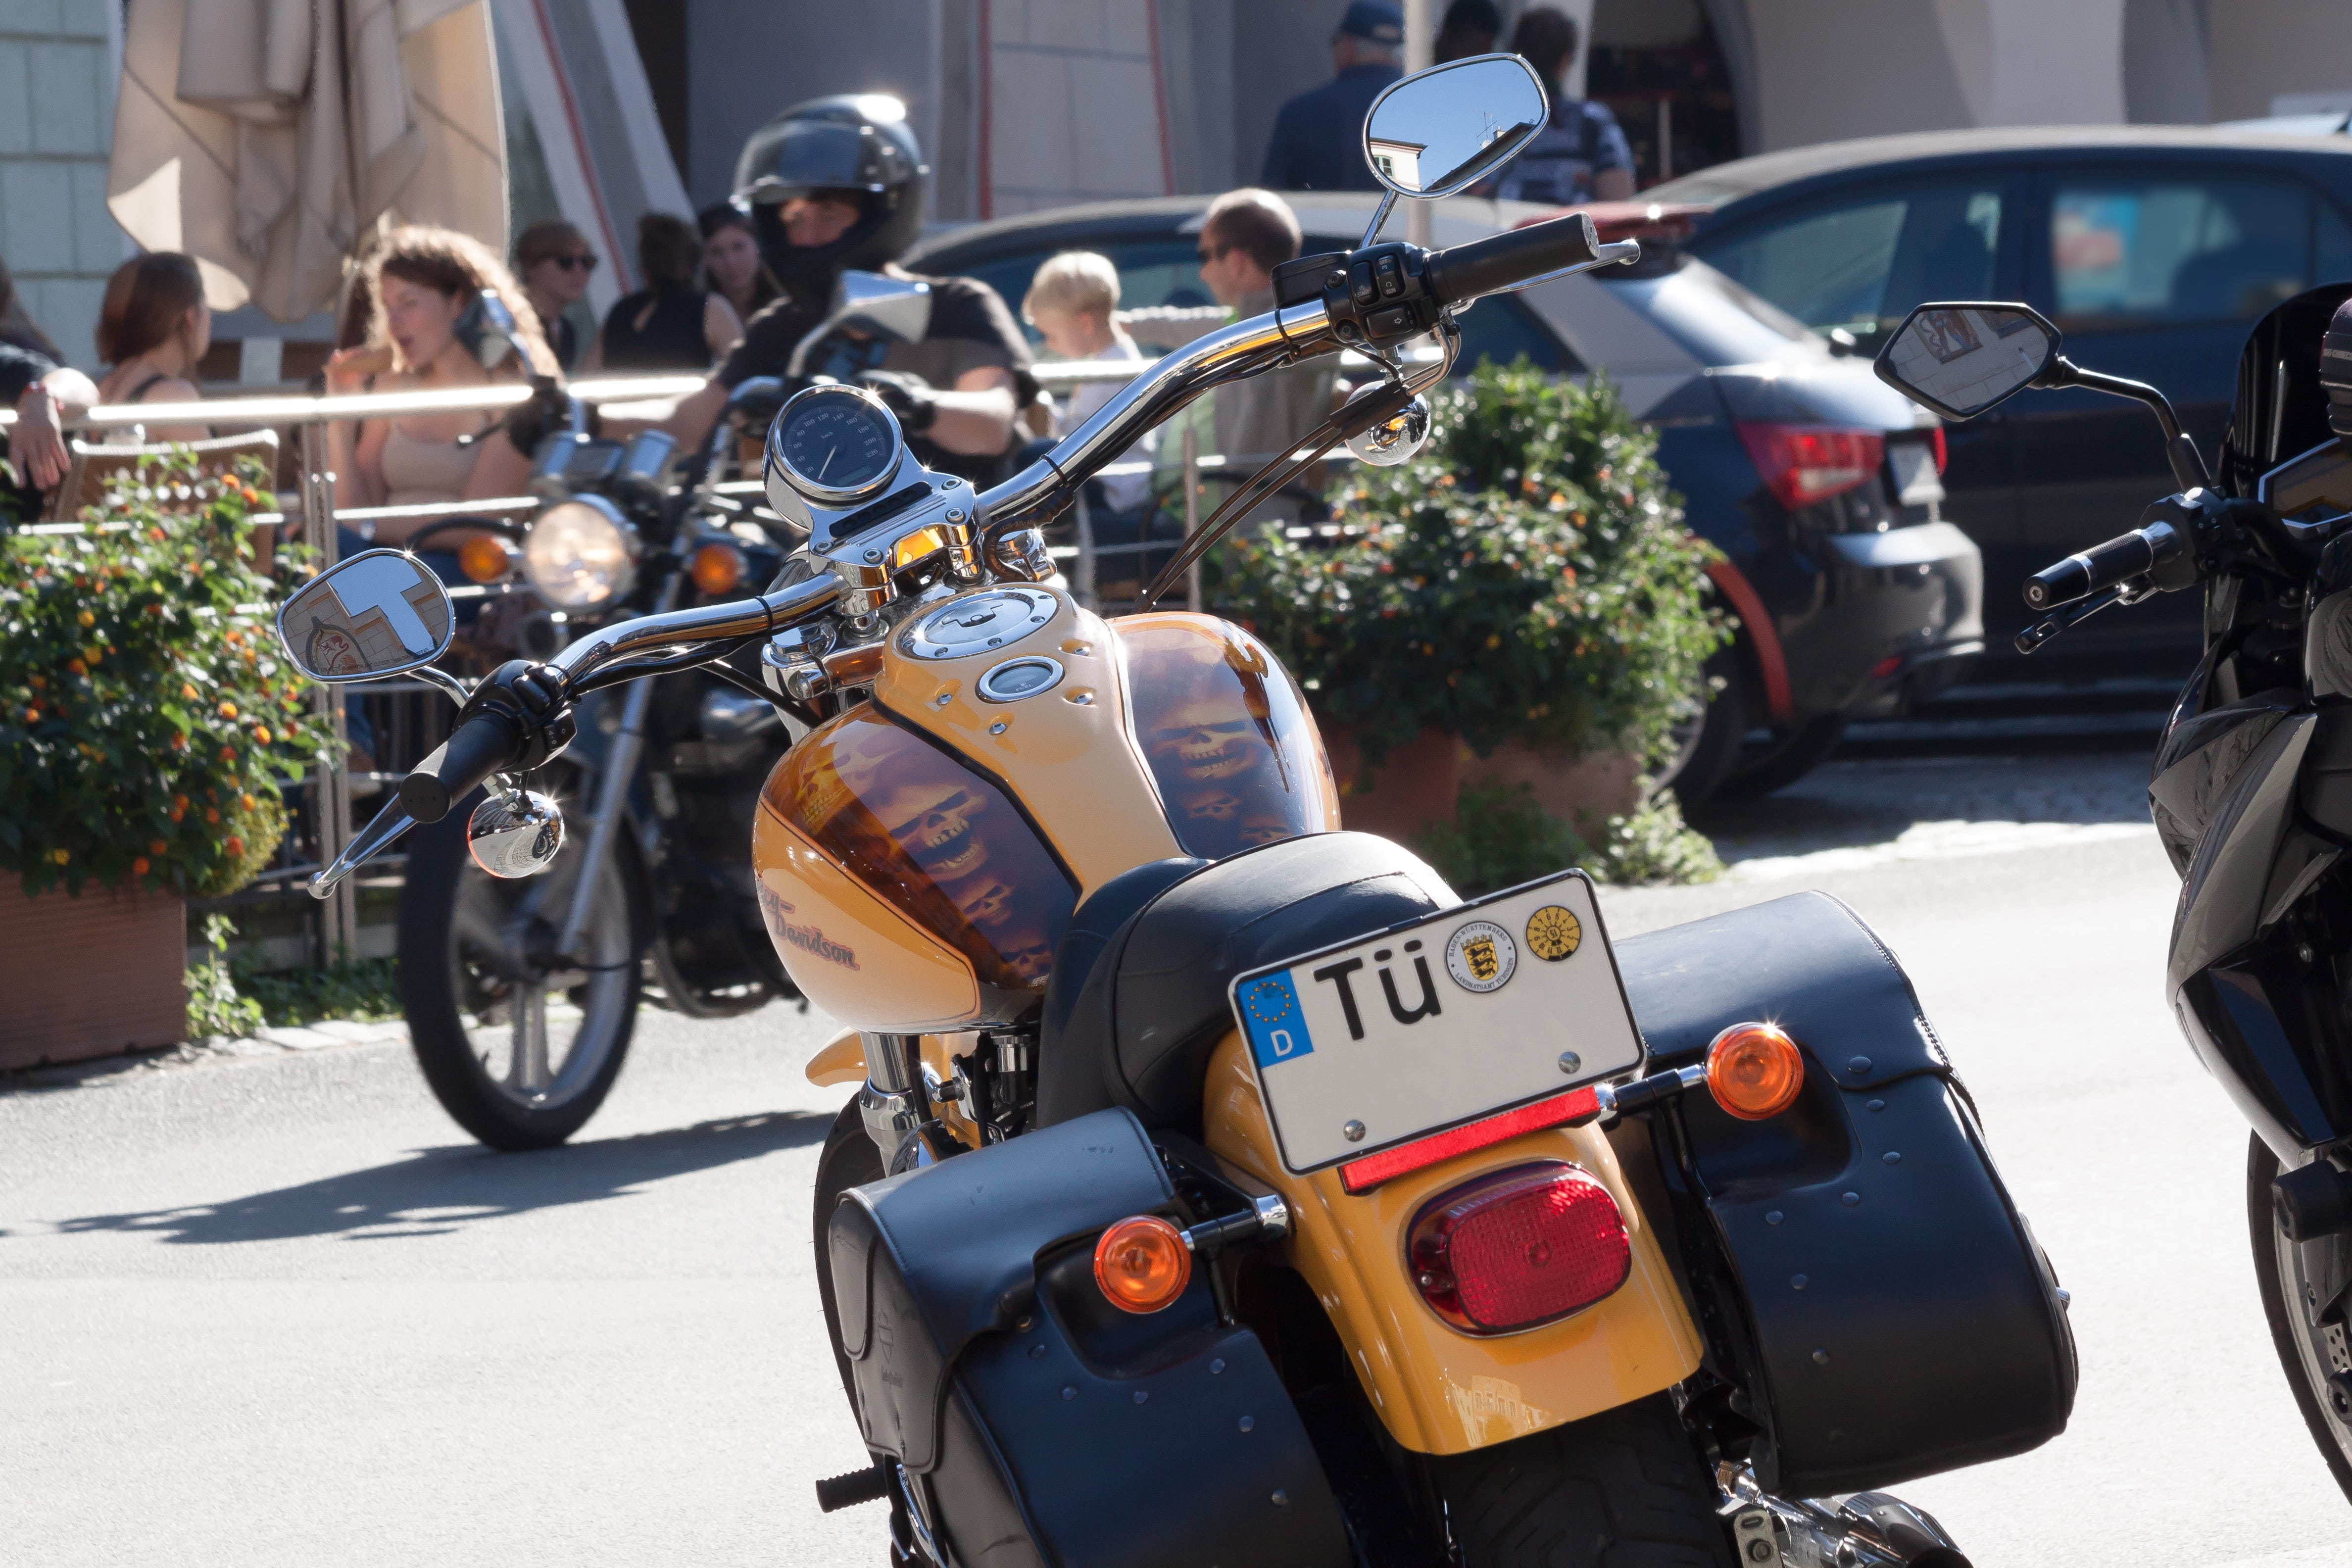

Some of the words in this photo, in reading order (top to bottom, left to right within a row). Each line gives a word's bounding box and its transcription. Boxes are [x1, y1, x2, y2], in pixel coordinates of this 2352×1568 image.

[818, 412, 829, 421] 120
[833, 413, 844, 421] 140
[804, 418, 815, 427] 100
[857, 426, 870, 434] 180
[864, 437, 877, 446] 200
[865, 449, 879, 458] 220
[774, 915, 860, 971] Davidson
[1449, 924, 1508, 957] BADEN-WÜRTTEMBERG
[1455, 971, 1496, 990] LANDRATSAMT
[1270, 1029, 1293, 1057] D
